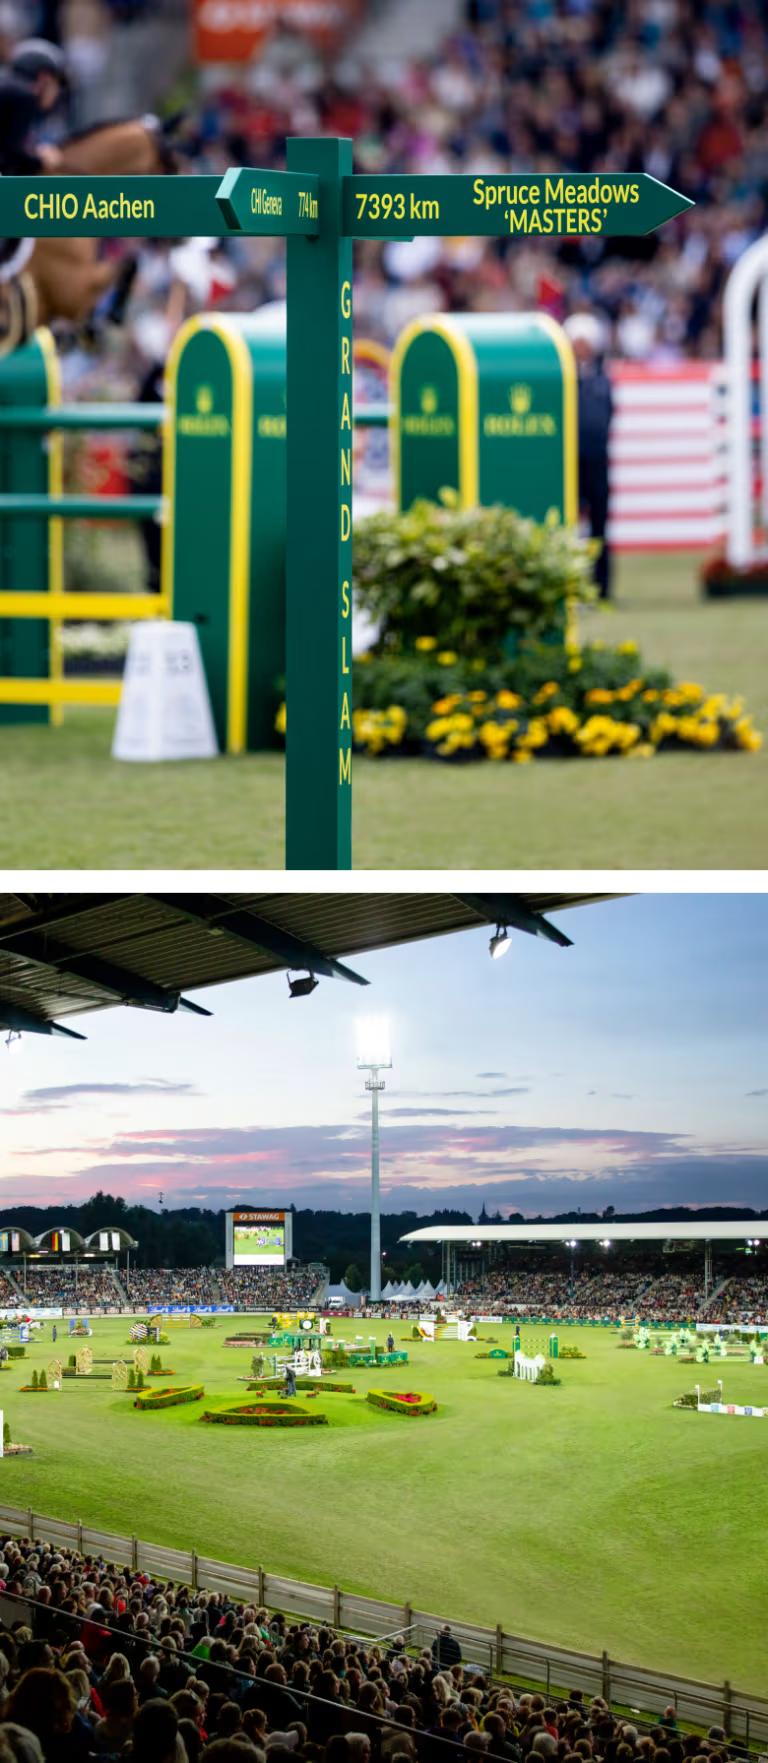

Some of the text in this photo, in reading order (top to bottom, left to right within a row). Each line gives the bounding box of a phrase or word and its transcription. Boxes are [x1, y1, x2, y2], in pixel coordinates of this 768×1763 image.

[24, 192, 155, 219] CHIO Aachen
[251, 188, 282, 215] CHI Geneva
[298, 191, 318, 219] 774 km
[355, 193, 440, 220] 7393 km
[473, 177, 639, 210] Spruce Meadows
[338, 281, 352, 785] GRAND SLAM
